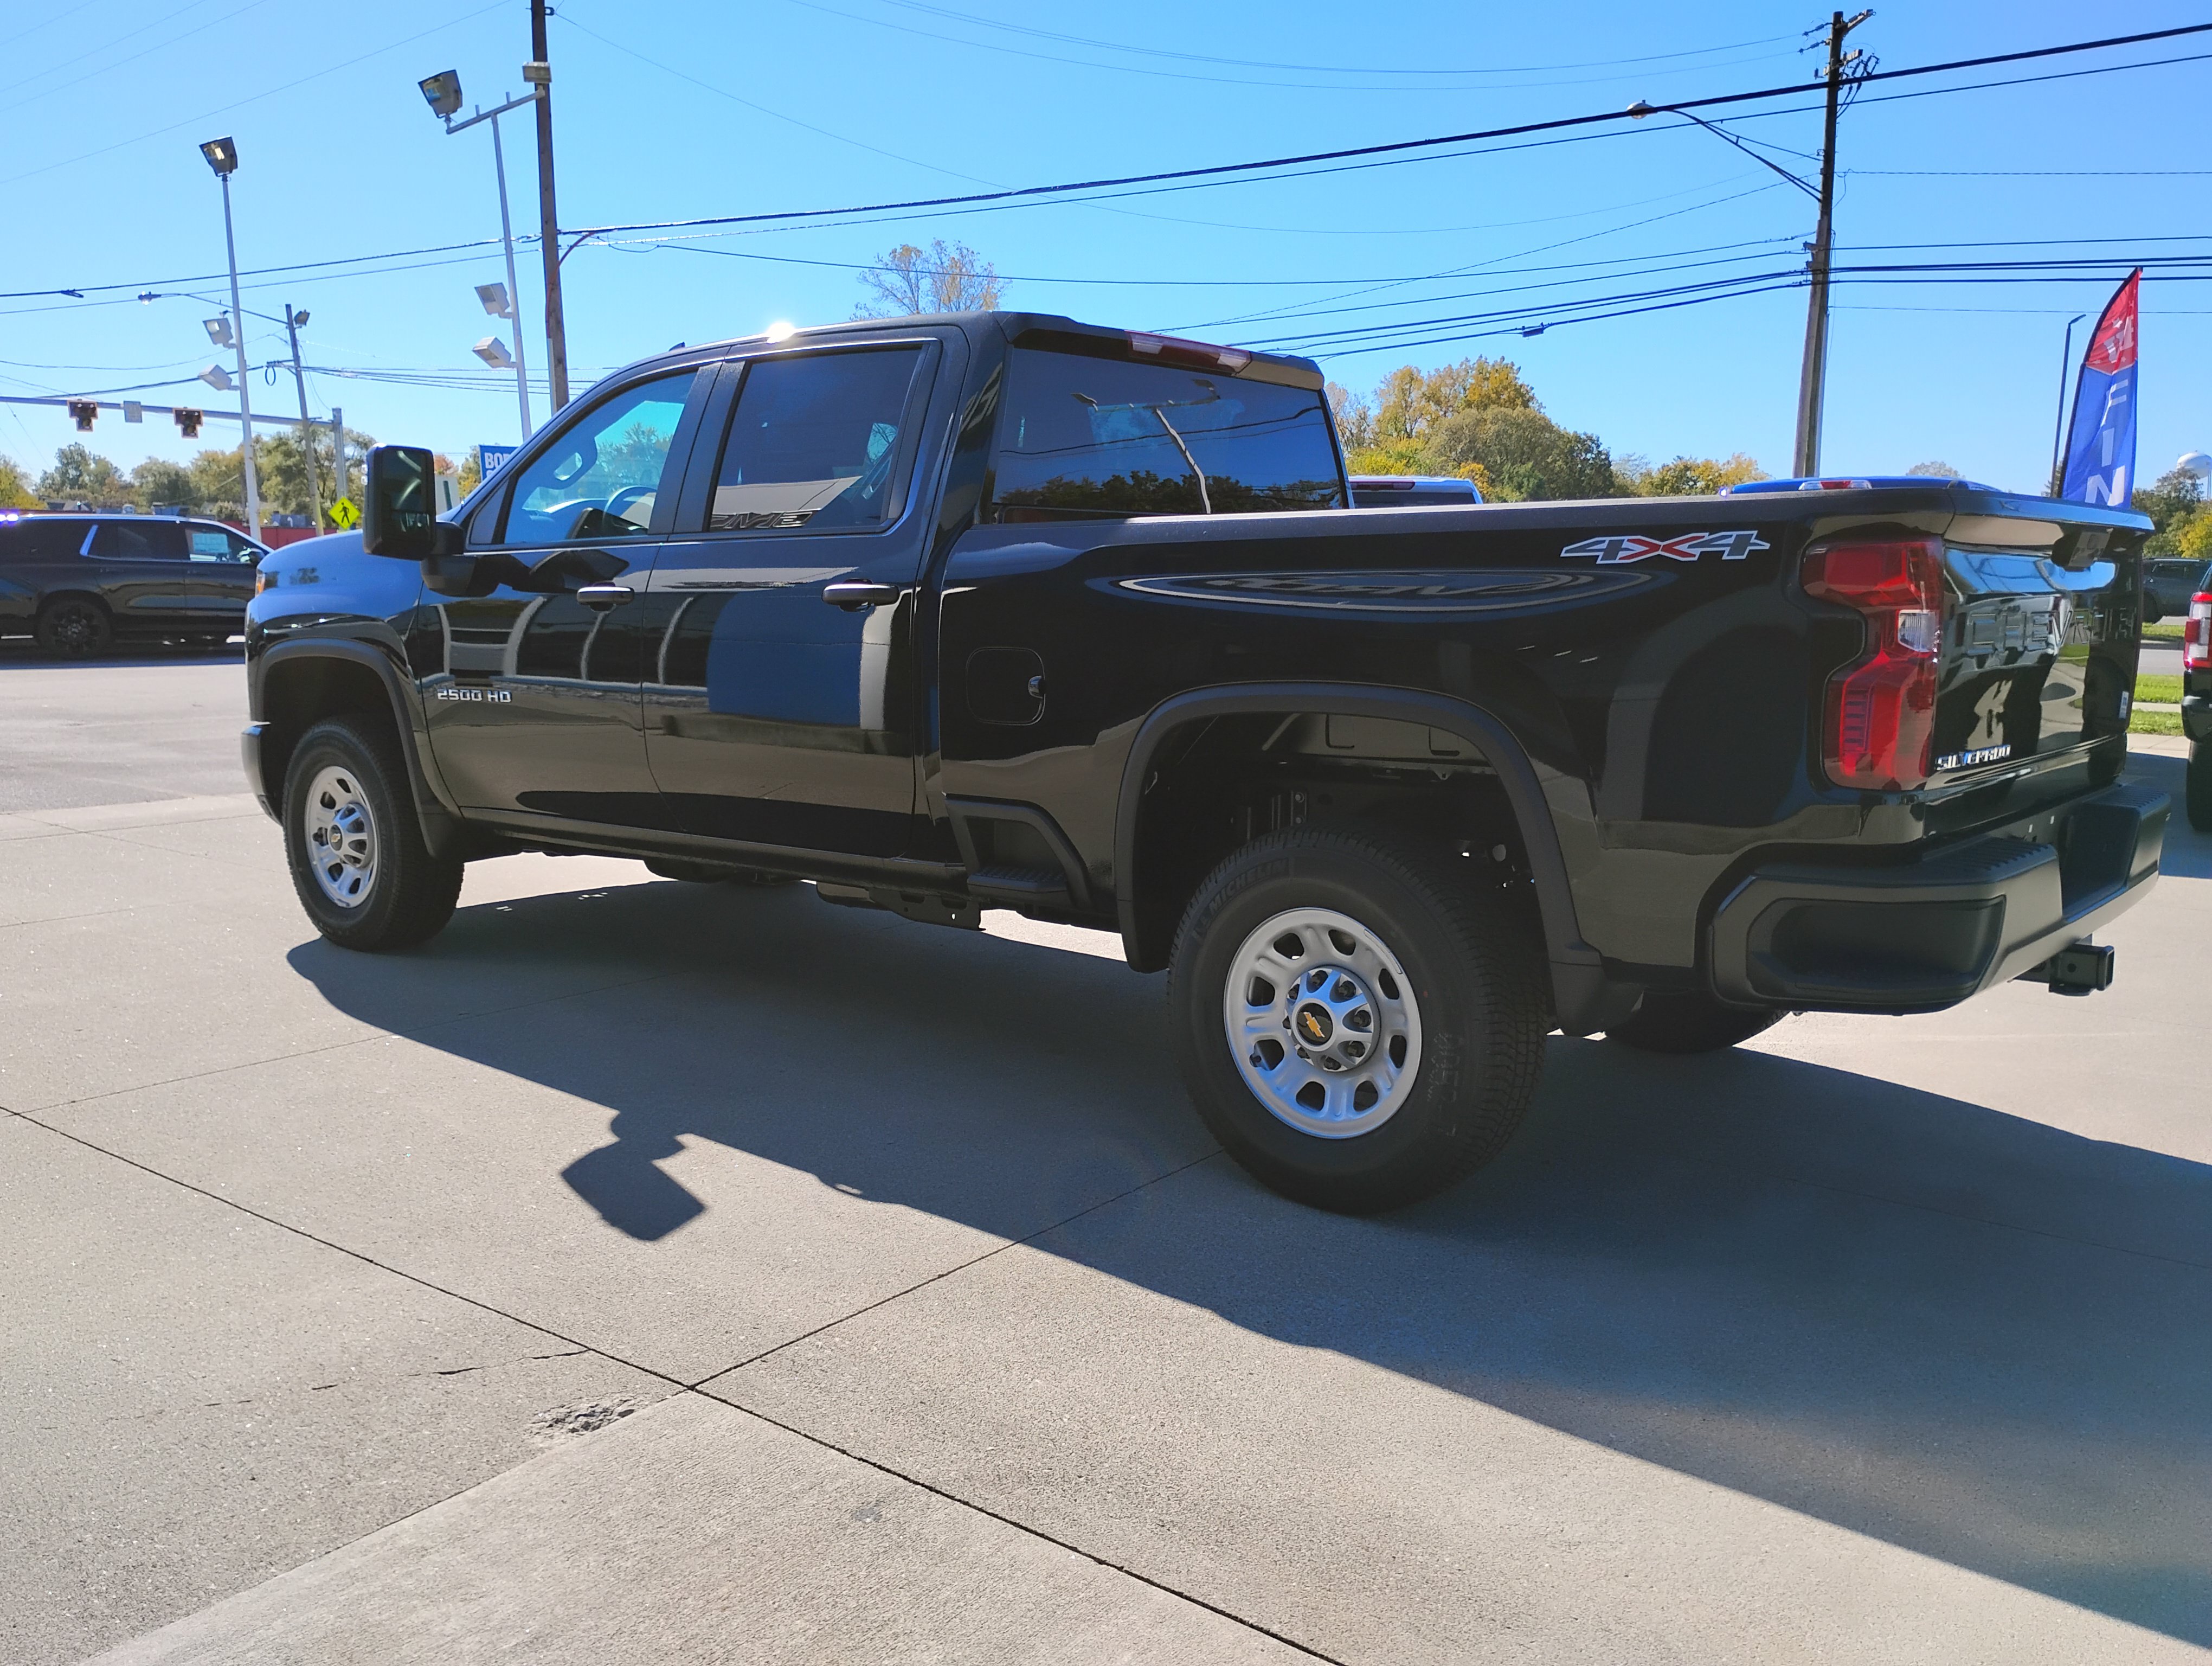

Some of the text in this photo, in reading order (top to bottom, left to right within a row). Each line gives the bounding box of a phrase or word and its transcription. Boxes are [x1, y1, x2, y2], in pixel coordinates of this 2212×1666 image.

[438, 688, 511, 703] 2500 HD
[1935, 744, 2011, 771] SILVERADO
[1209, 857, 1289, 914] MICHELIN
